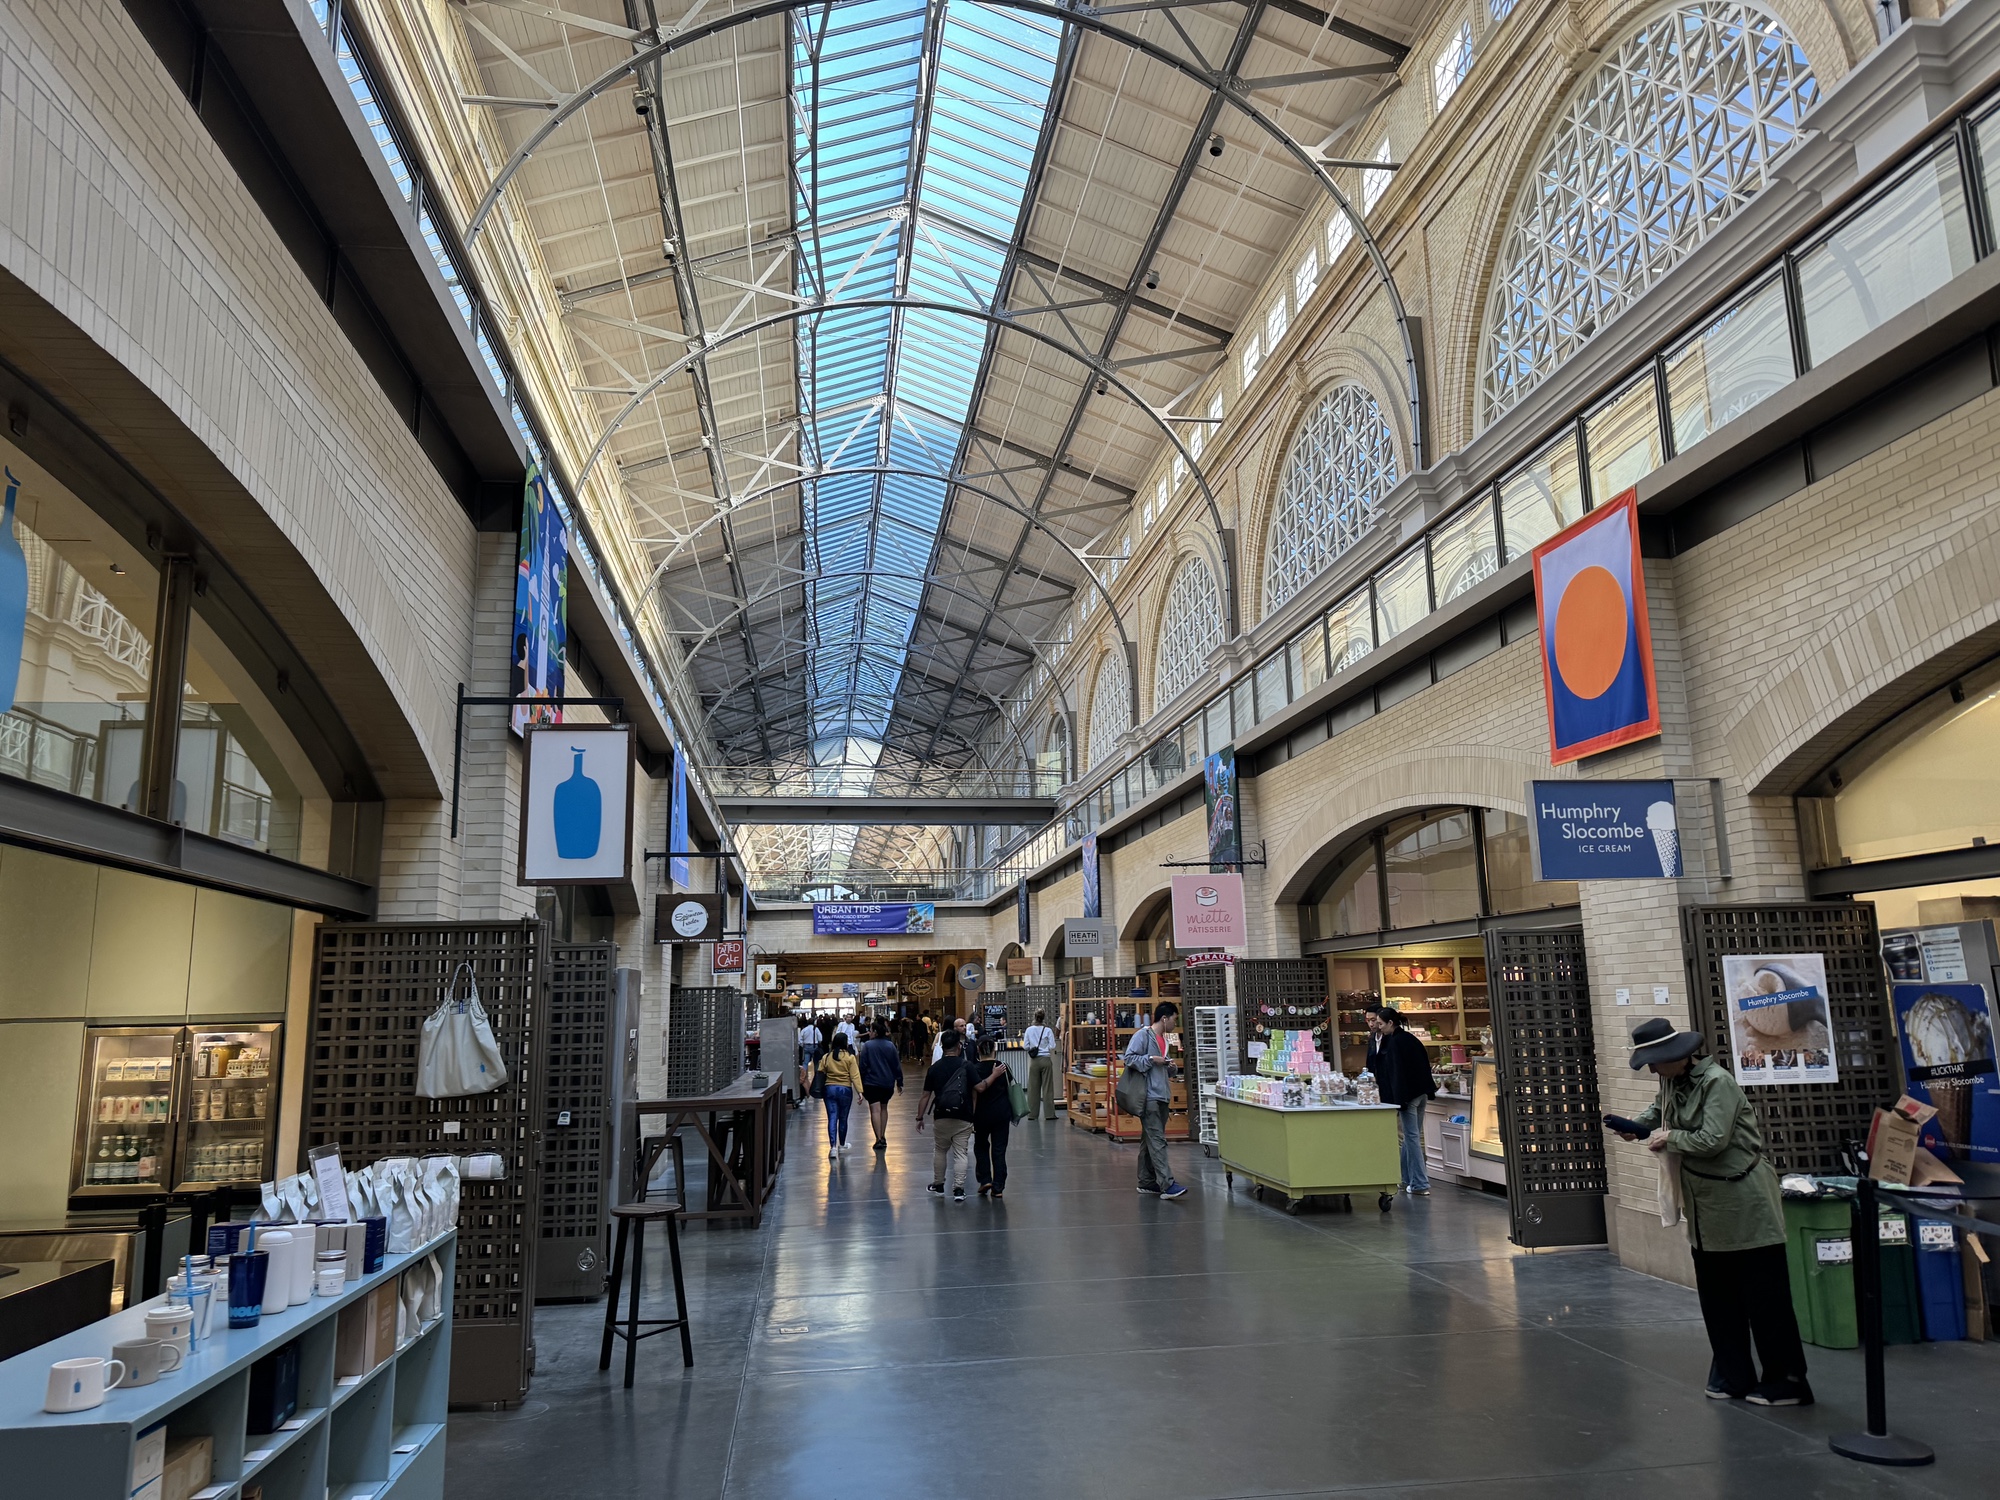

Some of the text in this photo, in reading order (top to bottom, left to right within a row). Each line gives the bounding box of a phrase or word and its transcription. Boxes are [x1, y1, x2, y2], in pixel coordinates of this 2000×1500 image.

[1541, 802, 1621, 824] Humphry
[1561, 822, 1644, 839] Slocombe
[1578, 844, 1631, 853] ICE CREAM
[817, 905, 881, 914] URBAN TIDES
[1186, 909, 1233, 924] miette
[717, 942, 741, 954] FATTED
[717, 954, 740, 967] CALF
[1747, 990, 1810, 1007] Humphry Slocombe
[1288, 1005, 1324, 1016] CREAM
[1930, 1064, 1965, 1076] #LICKTHAT
[1920, 1076, 1985, 1090] Humphry Slocombe
[229, 1304, 262, 1318] NOLA
